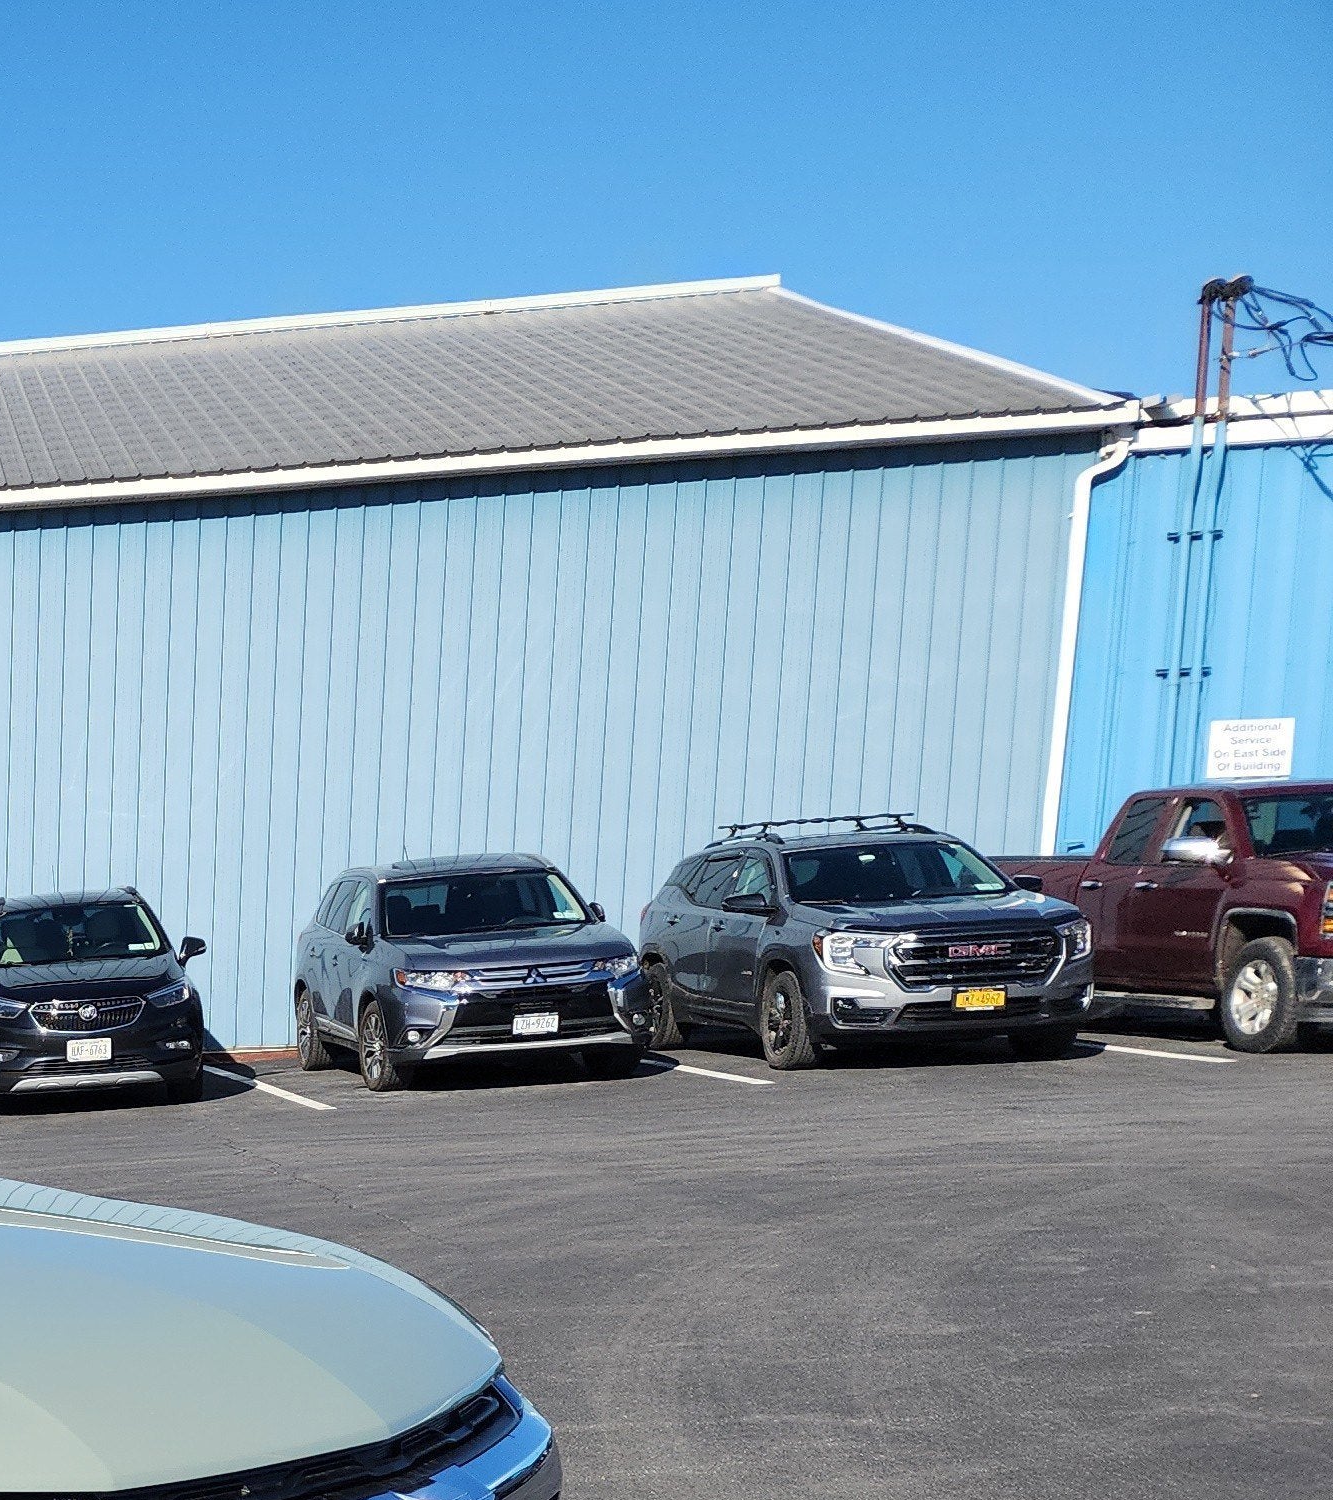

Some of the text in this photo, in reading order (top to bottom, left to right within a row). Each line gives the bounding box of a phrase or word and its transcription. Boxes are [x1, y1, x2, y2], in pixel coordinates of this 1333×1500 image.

[1223, 722, 1282, 732] Additional
[1230, 737, 1272, 745] Service
[1214, 748, 1287, 758] On East Side
[1234, 762, 1281, 771] Building
